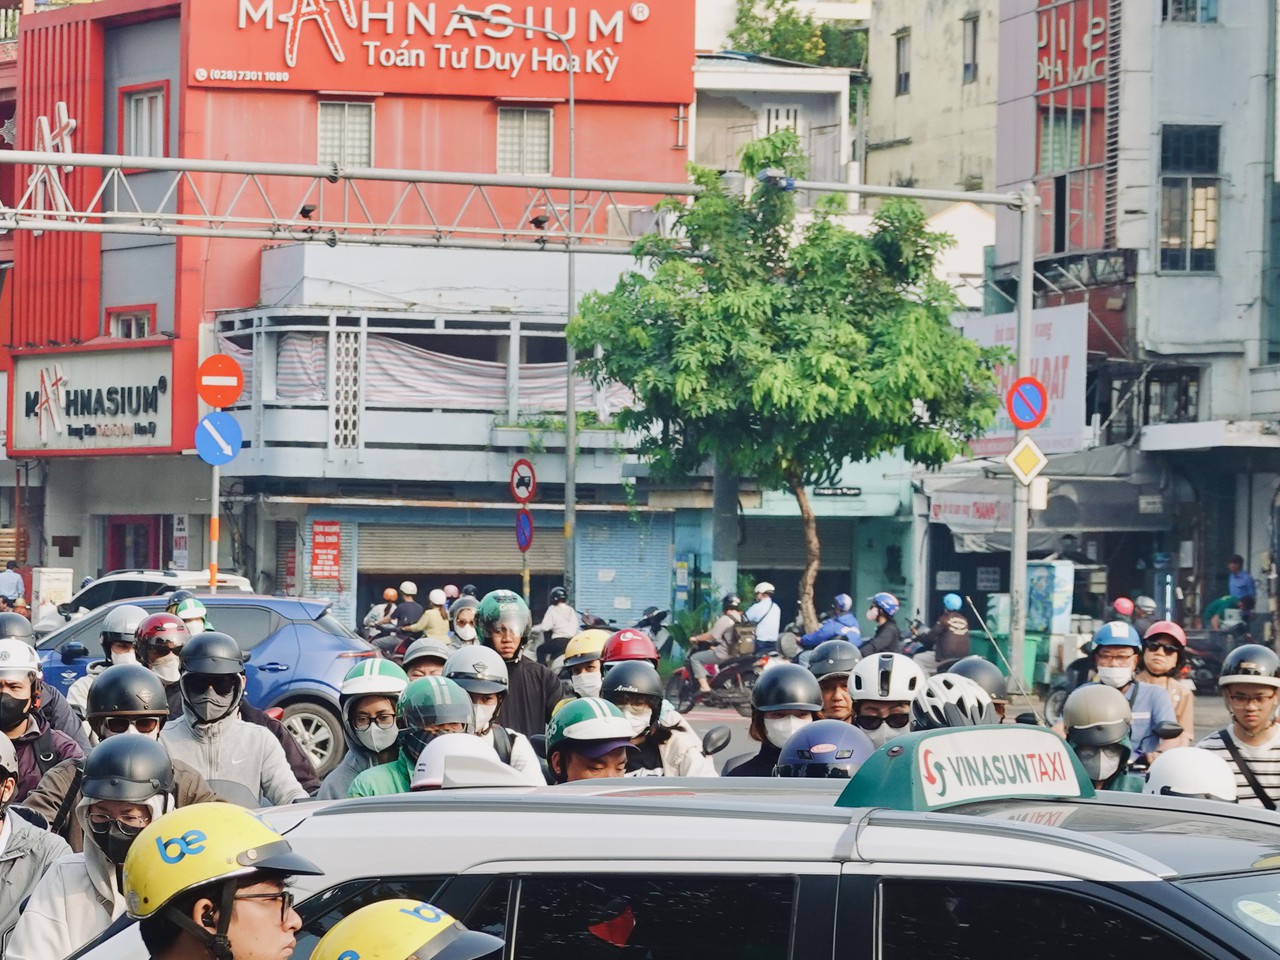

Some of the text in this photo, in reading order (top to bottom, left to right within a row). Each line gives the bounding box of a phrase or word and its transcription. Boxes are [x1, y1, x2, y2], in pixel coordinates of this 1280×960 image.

[209, 69, 289, 82] (028) 7301 1080
[362, 40, 619, 82] Toán Tư Duy Hoa Kỳ
[156, 829, 207, 864] be
